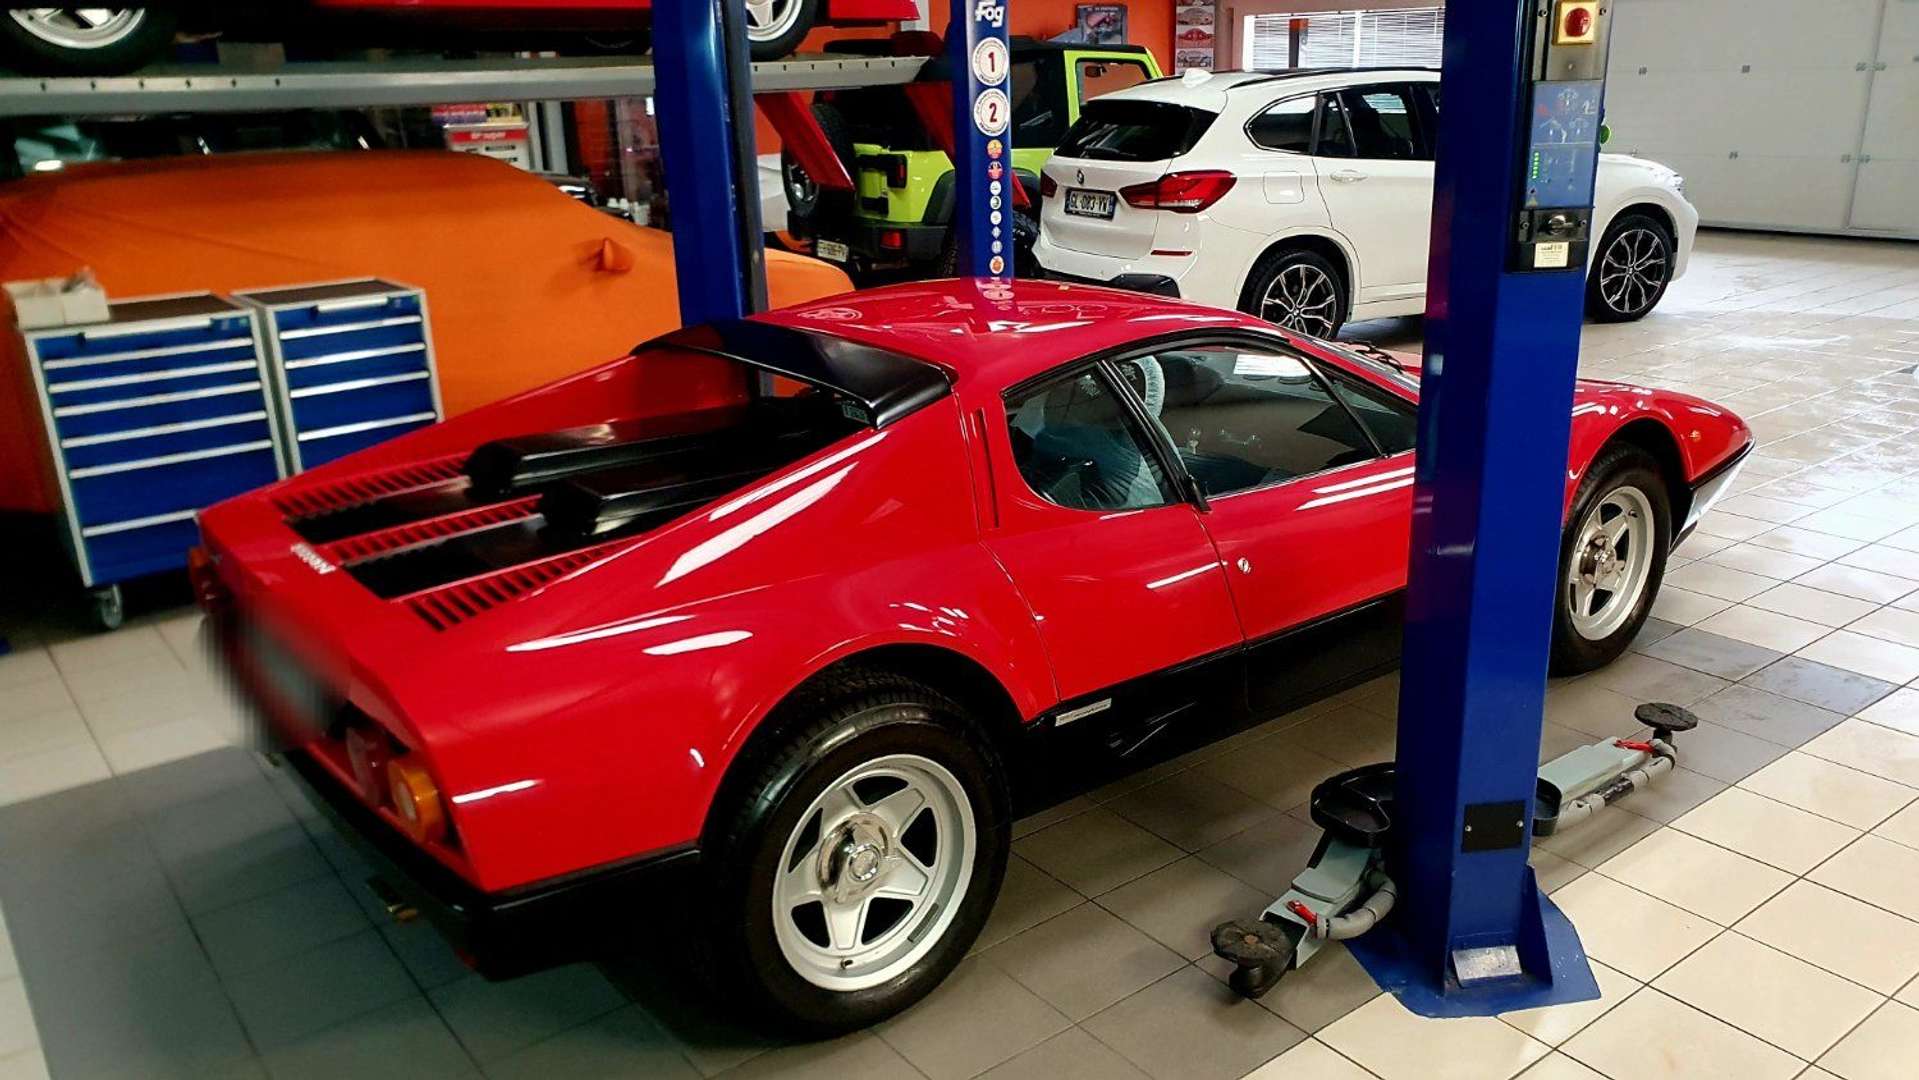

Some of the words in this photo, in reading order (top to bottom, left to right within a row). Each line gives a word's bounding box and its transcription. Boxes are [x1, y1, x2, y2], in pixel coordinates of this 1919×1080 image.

[975, 1, 1004, 28] Fog
[988, 52, 995, 72] 1
[988, 102, 998, 123] 2
